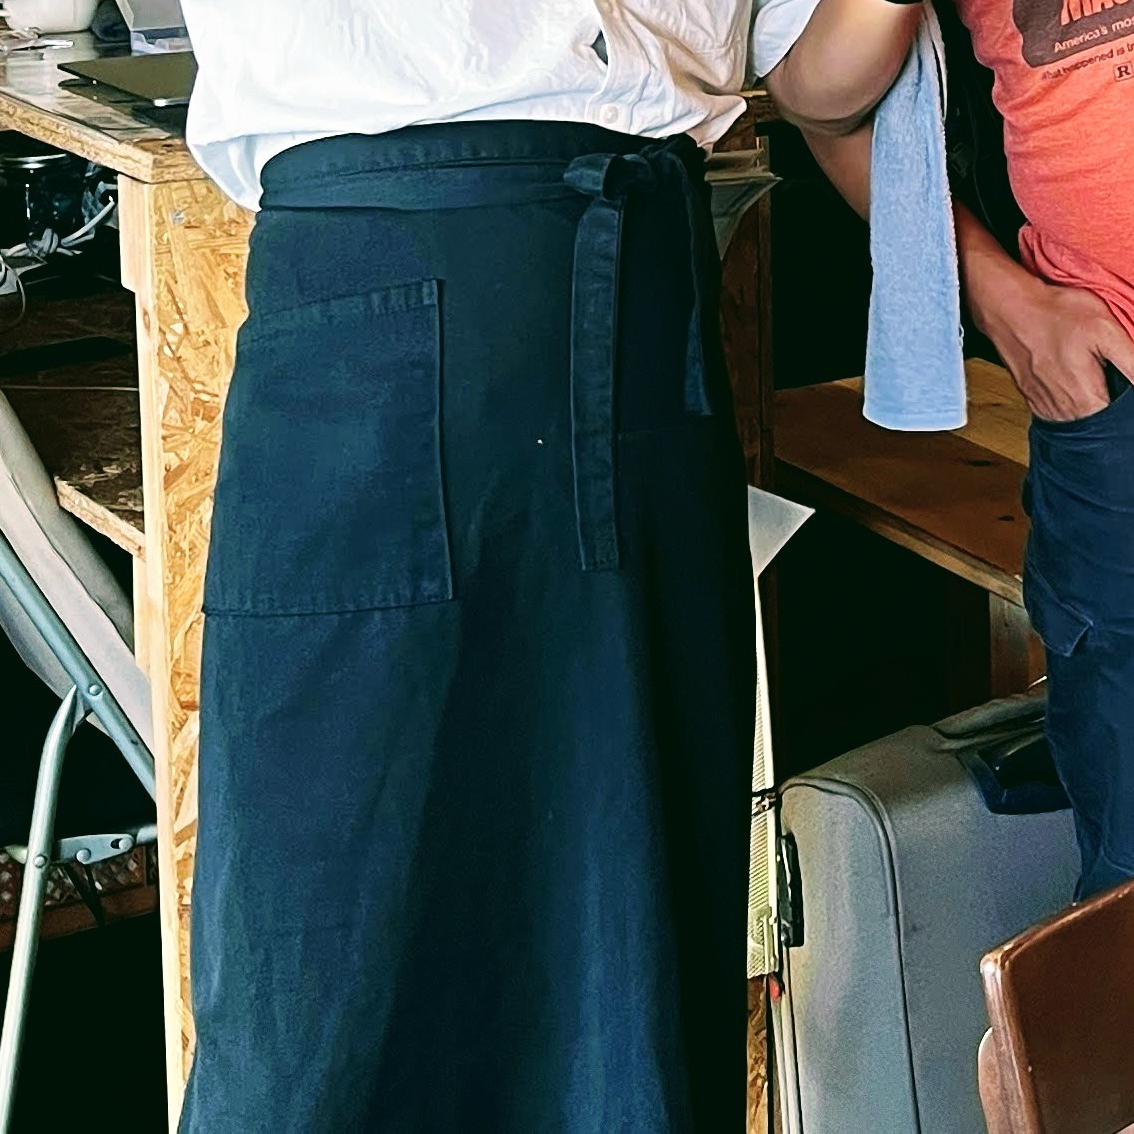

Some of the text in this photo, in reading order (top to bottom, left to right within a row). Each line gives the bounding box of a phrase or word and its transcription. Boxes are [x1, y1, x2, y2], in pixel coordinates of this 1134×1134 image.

[1060, 48, 1115, 75] happened
[1115, 45, 1126, 57] is
[1114, 63, 1133, 80] R
